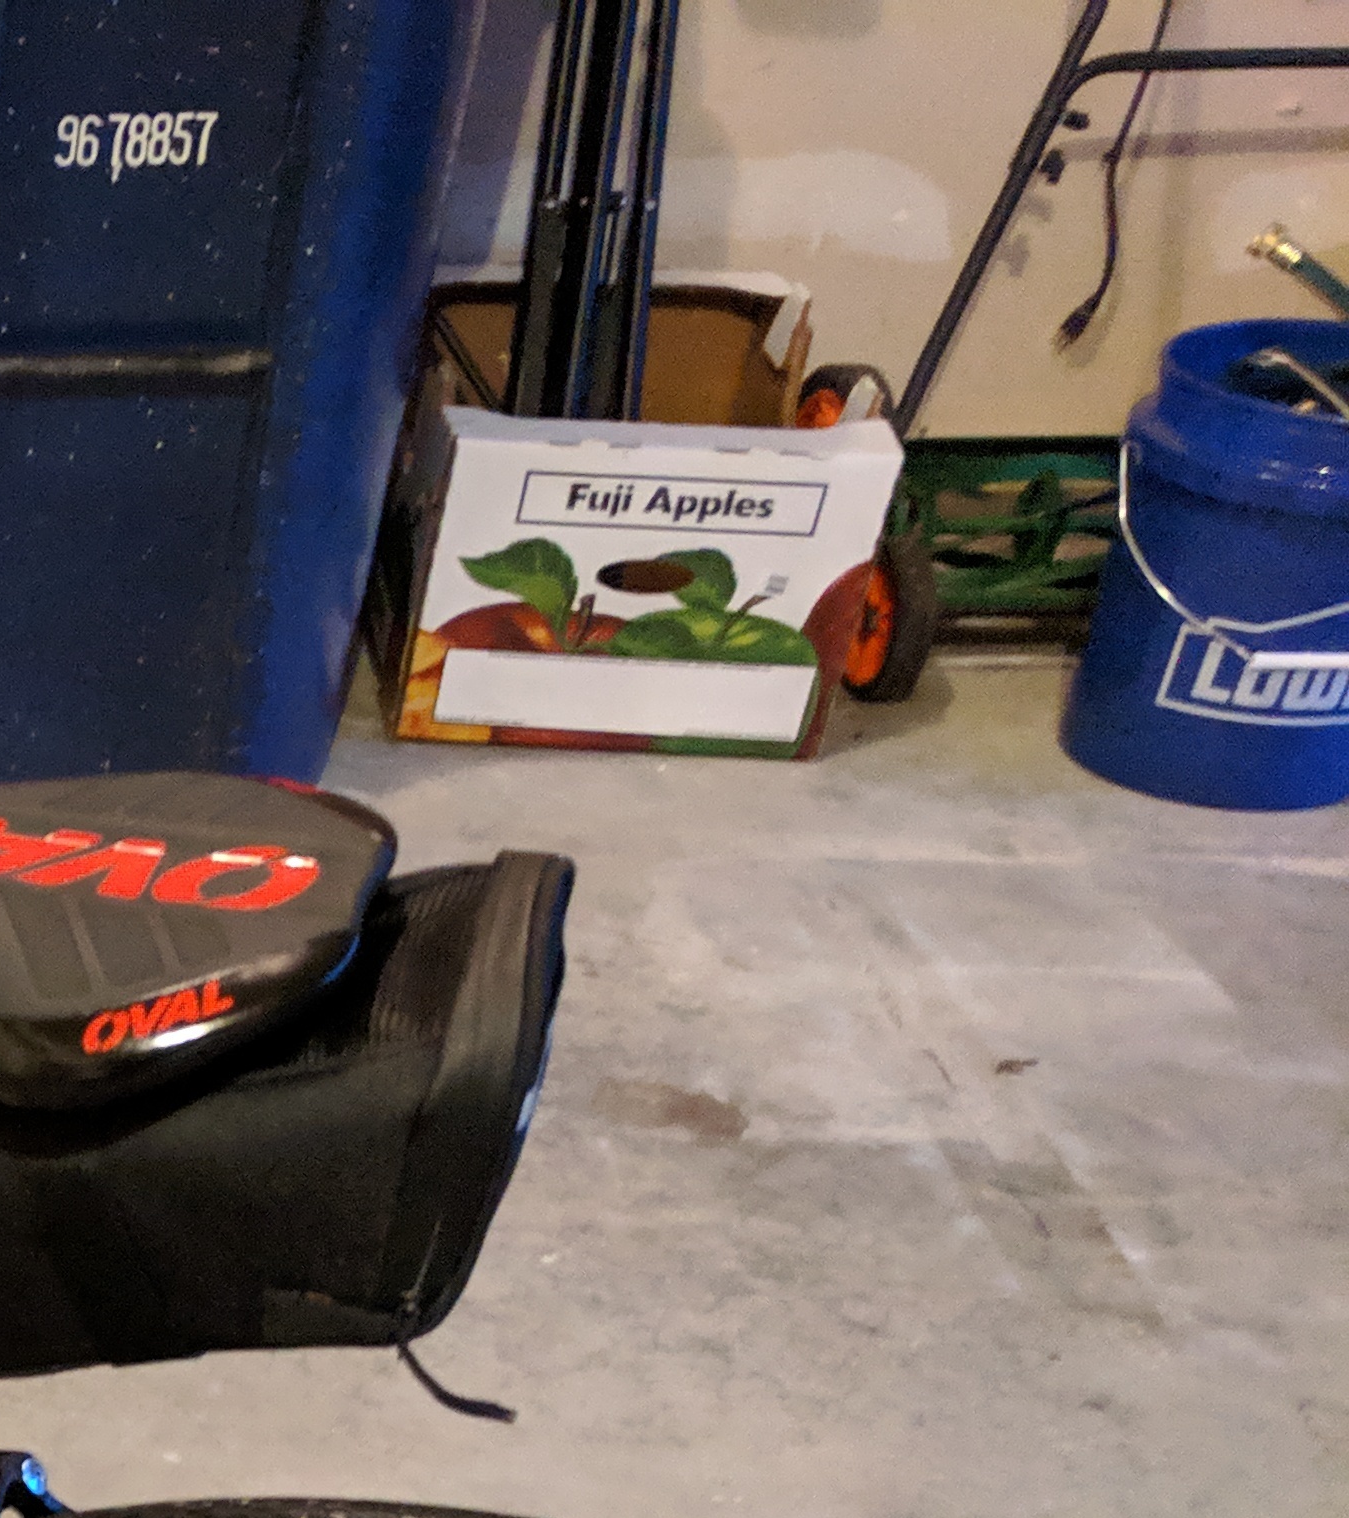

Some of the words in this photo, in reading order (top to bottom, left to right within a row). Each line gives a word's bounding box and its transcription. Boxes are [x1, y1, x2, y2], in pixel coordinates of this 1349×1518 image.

[54, 111, 219, 184] 9678857
[565, 482, 635, 518] Fuji
[644, 485, 774, 523] Apples
[1190, 638, 1349, 711] LOW
[81, 979, 235, 1056] OVAL
